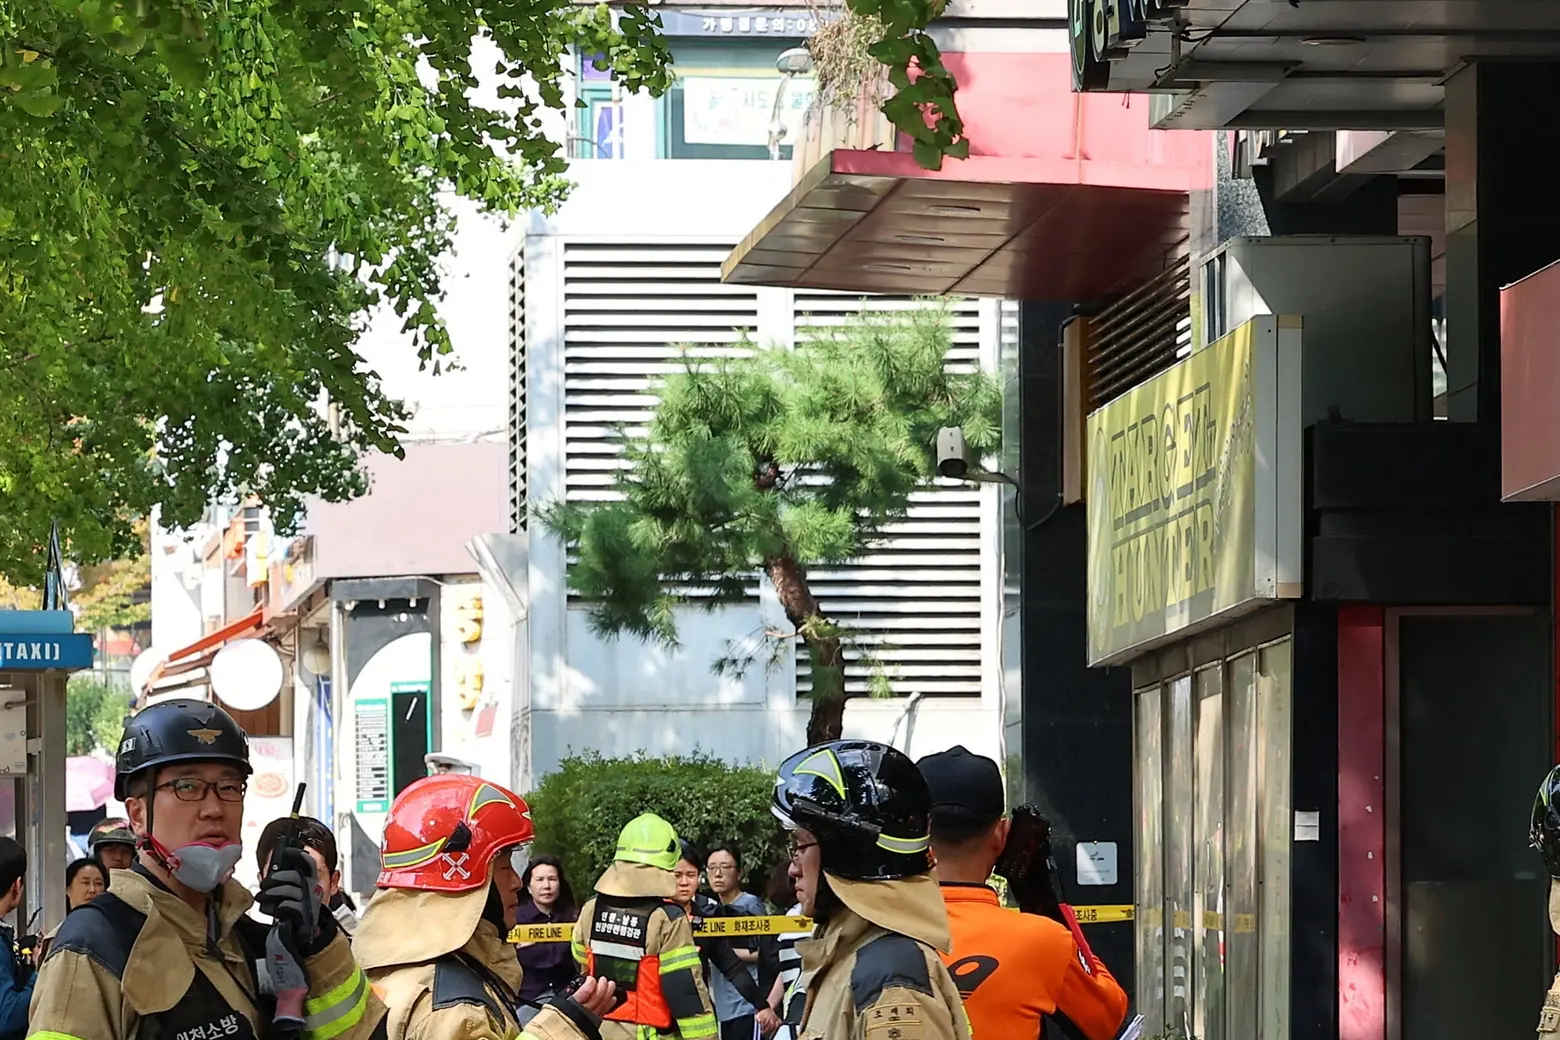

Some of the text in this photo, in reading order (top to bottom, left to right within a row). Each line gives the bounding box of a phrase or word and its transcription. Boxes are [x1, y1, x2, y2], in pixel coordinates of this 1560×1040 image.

[1111, 383, 1216, 531] TARGET
[1111, 498, 1215, 630] HUNTER
[710, 921, 726, 933] LINE
[733, 919, 771, 932] 화재조사중
[528, 926, 562, 939] FIRE LINE
